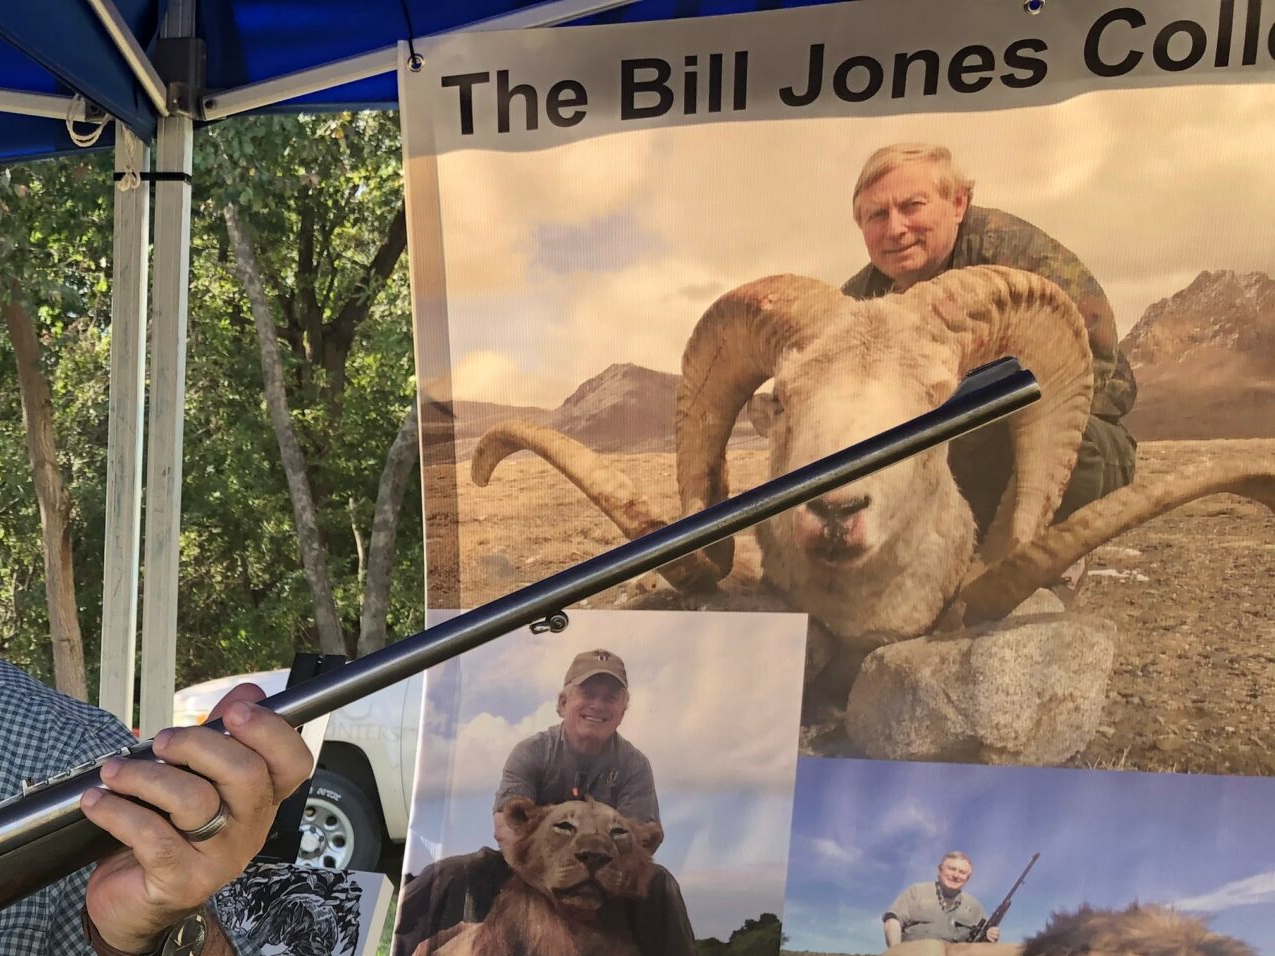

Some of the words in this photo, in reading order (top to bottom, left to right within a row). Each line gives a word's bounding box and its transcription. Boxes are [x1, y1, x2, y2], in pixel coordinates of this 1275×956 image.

[441, 69, 589, 136] The
[620, 50, 749, 121] Bill
[779, 37, 1049, 108] Jones
[1083, 0, 1275, 78] Coll
